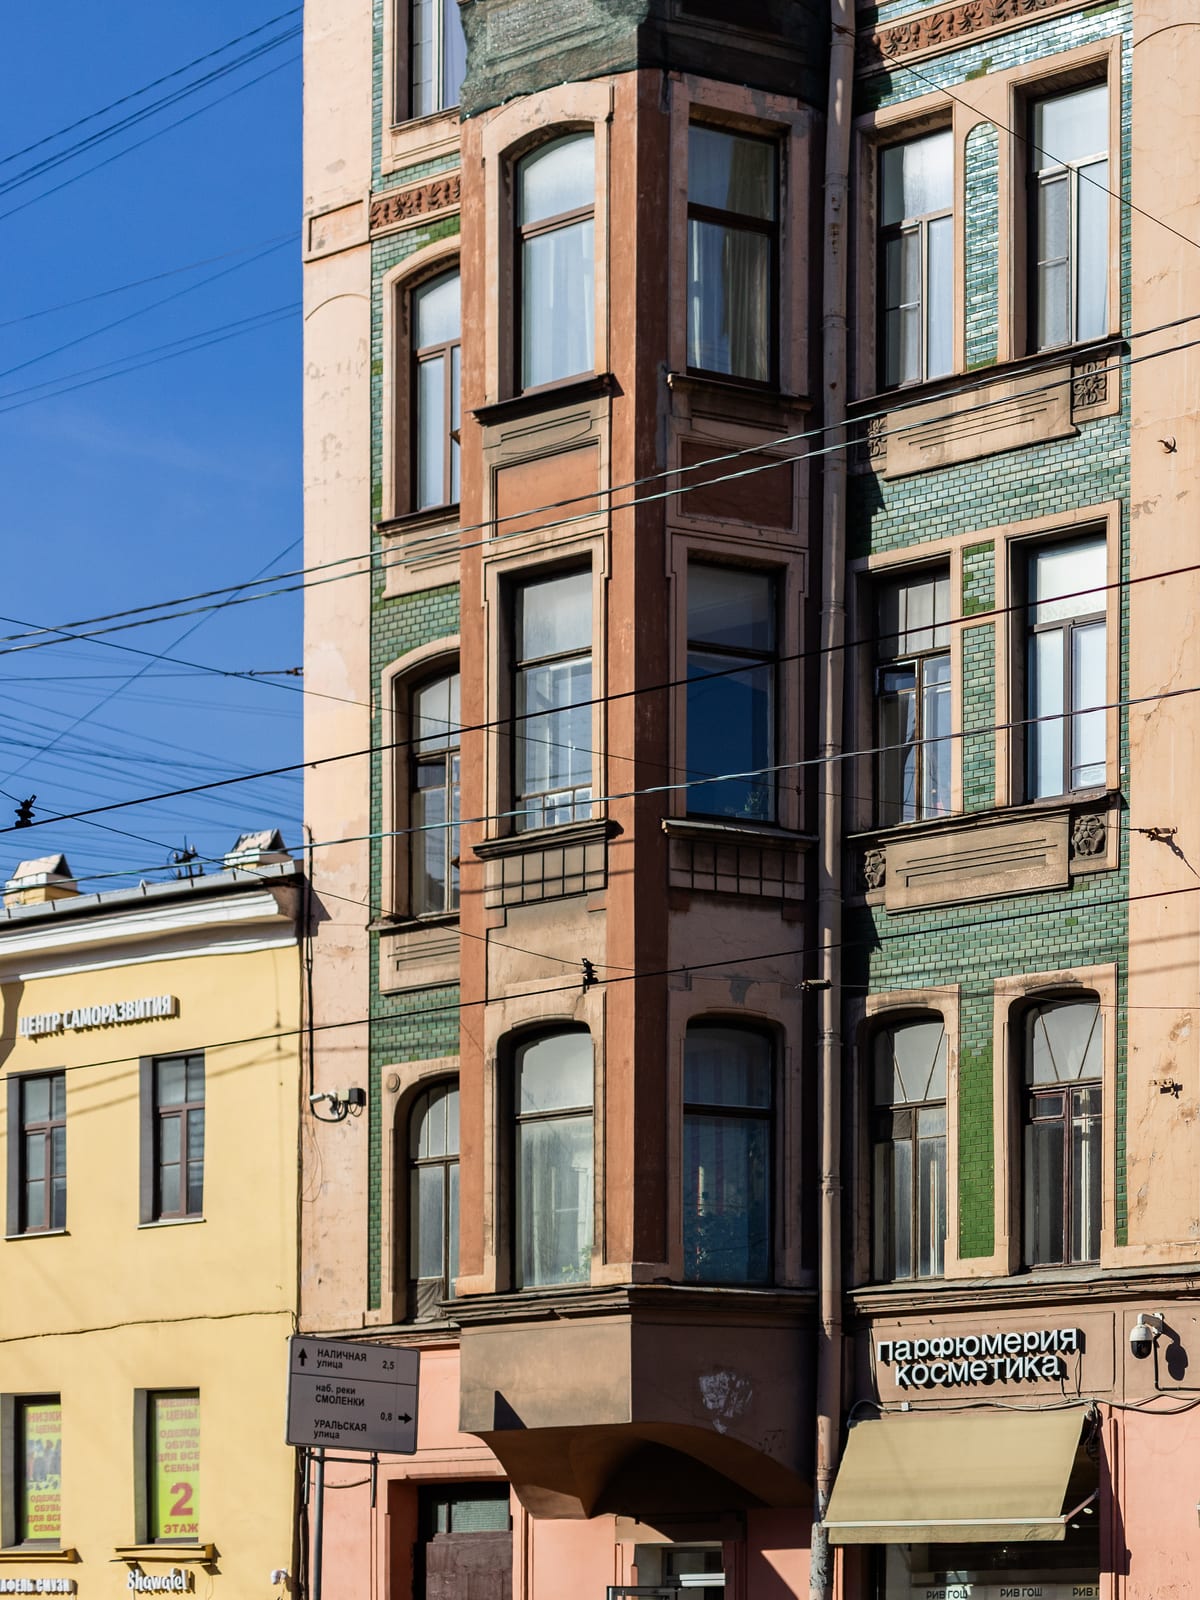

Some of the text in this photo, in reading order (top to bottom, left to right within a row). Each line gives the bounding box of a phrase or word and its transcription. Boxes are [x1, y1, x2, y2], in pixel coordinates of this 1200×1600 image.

[19, 994, 175, 1036] ЦЕНТР САМОРАЗВИТИЯ
[877, 1328, 1077, 1361] парфюмерия
[317, 1348, 367, 1362] НАЛИЧНАЯ
[316, 1359, 343, 1370] улица
[382, 1360, 395, 1370] 2,5
[895, 1355, 1060, 1386] косметика
[315, 1384, 356, 1396] наб. реки
[315, 1394, 365, 1407] СМОЛЕНКИ
[314, 1419, 367, 1432] УРАЛЬСКАЯ
[313, 1429, 340, 1440] улица
[170, 1482, 193, 1516] 2
[164, 1523, 199, 1534] ЭТАЖ
[926, 1590, 967, 1599] РИВ ГОШ
[1000, 1587, 1042, 1597] РИВ ГОШ
[1072, 1587, 1093, 1597] РИВ
